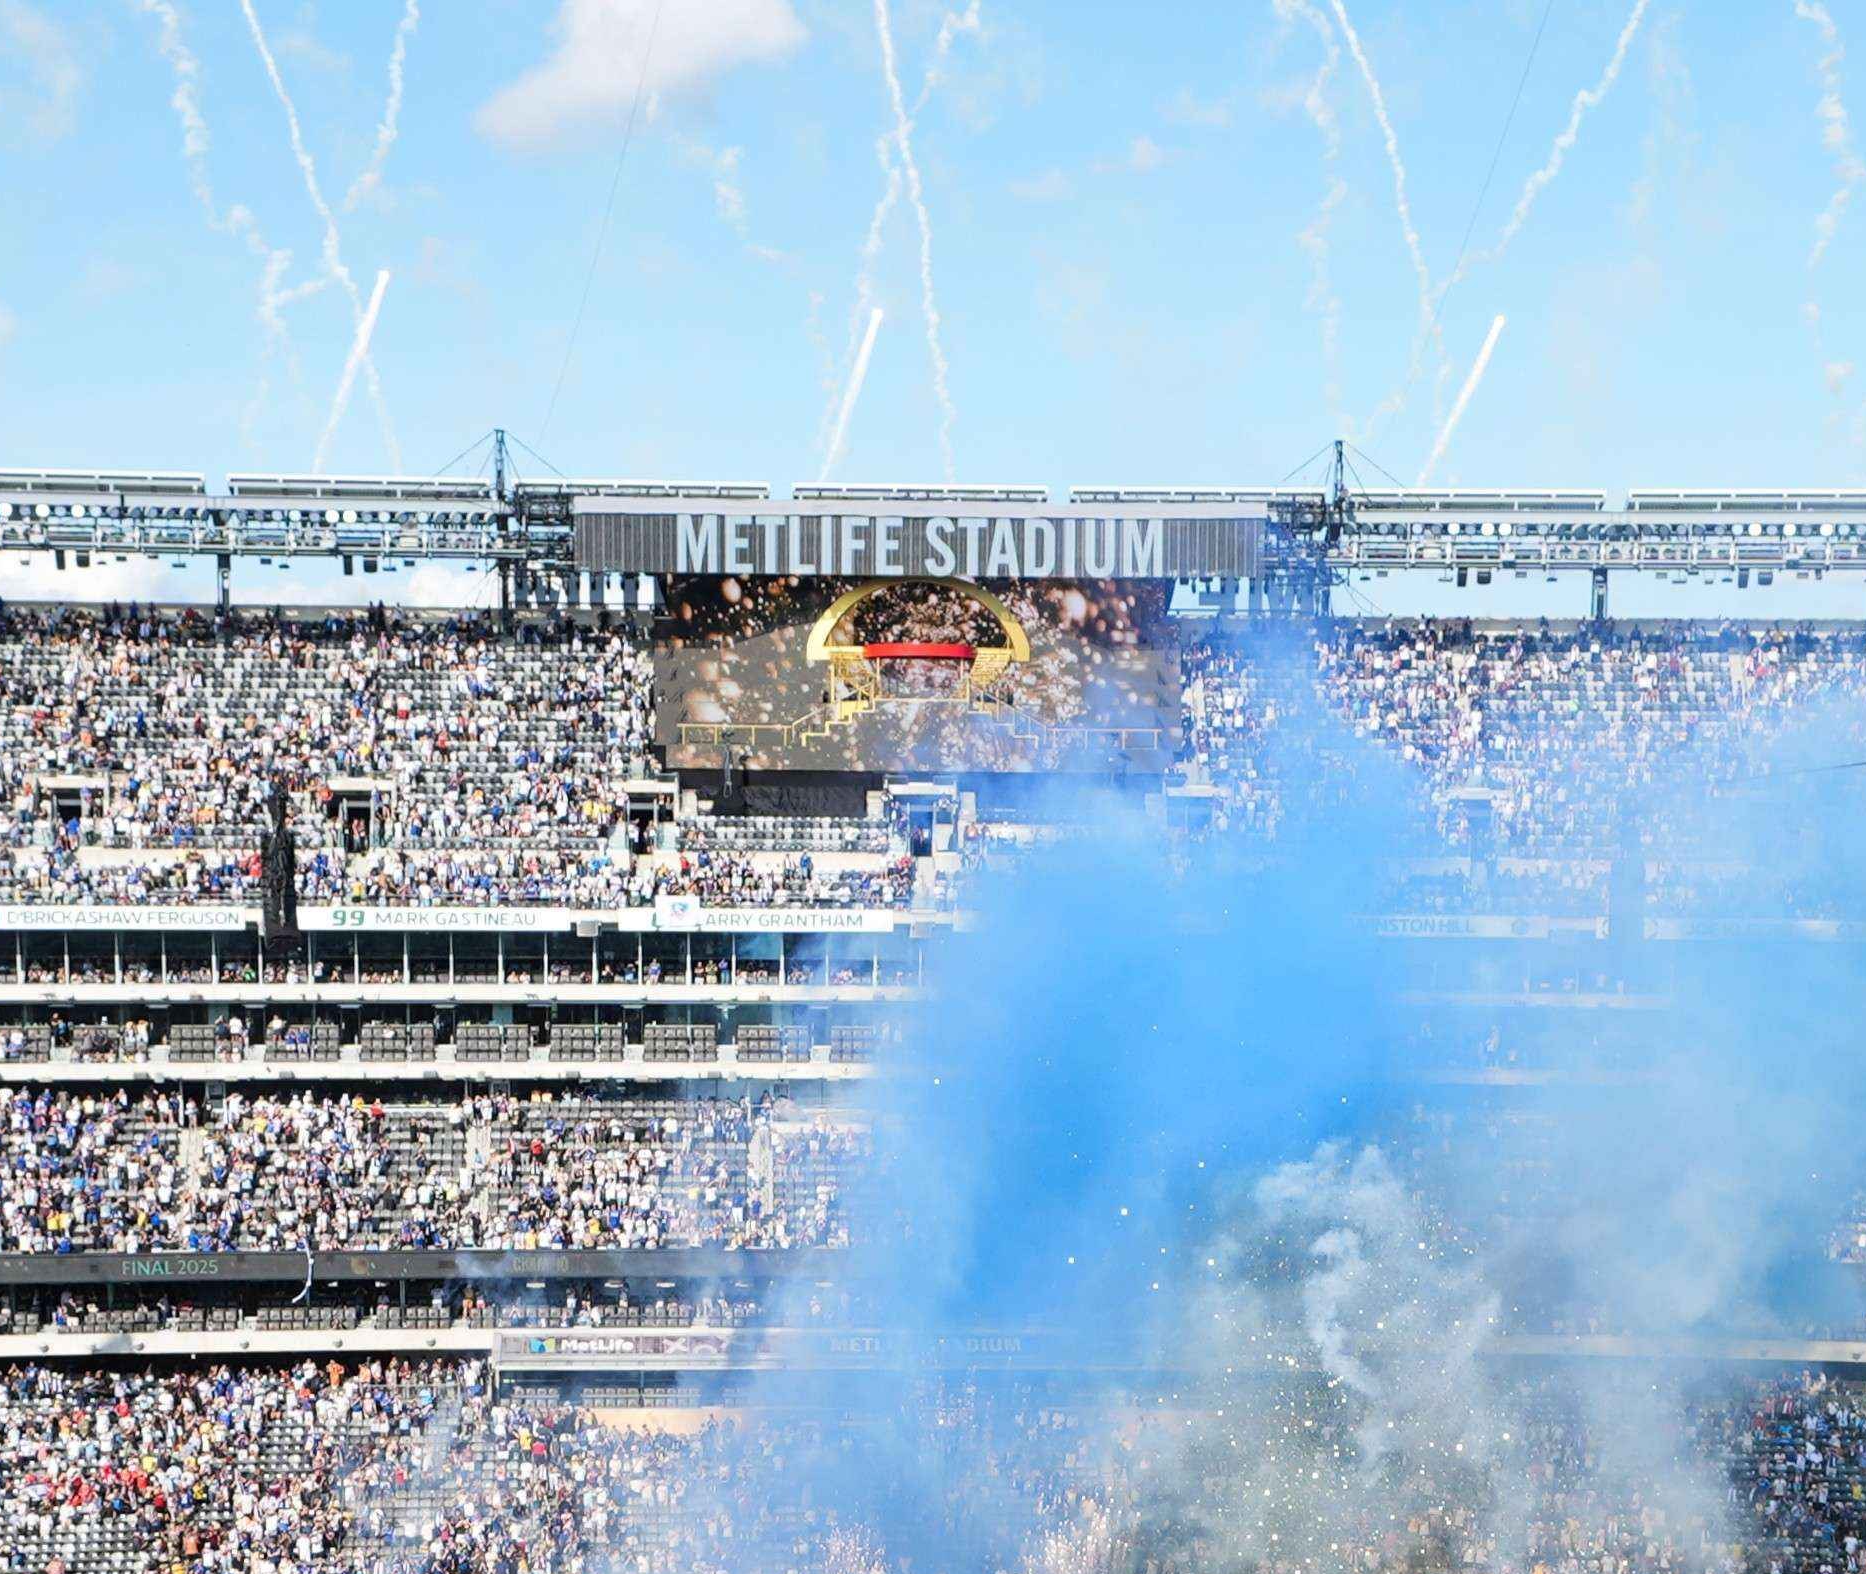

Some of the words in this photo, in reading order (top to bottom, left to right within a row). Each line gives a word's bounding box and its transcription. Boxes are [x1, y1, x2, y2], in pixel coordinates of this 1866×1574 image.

[676, 514, 905, 574] METLIFE
[924, 515, 1164, 578] STADIUM
[148, 910, 239, 925] FERGUSON
[332, 909, 365, 926] 99
[375, 911, 429, 925] MARK
[436, 911, 536, 925] GASTINEAU
[705, 913, 753, 926] ARRY
[758, 912, 863, 927] GRANTHAM
[122, 1259, 174, 1275] FINAL
[177, 1259, 219, 1275] 2025
[560, 1338, 634, 1352] MetLife
